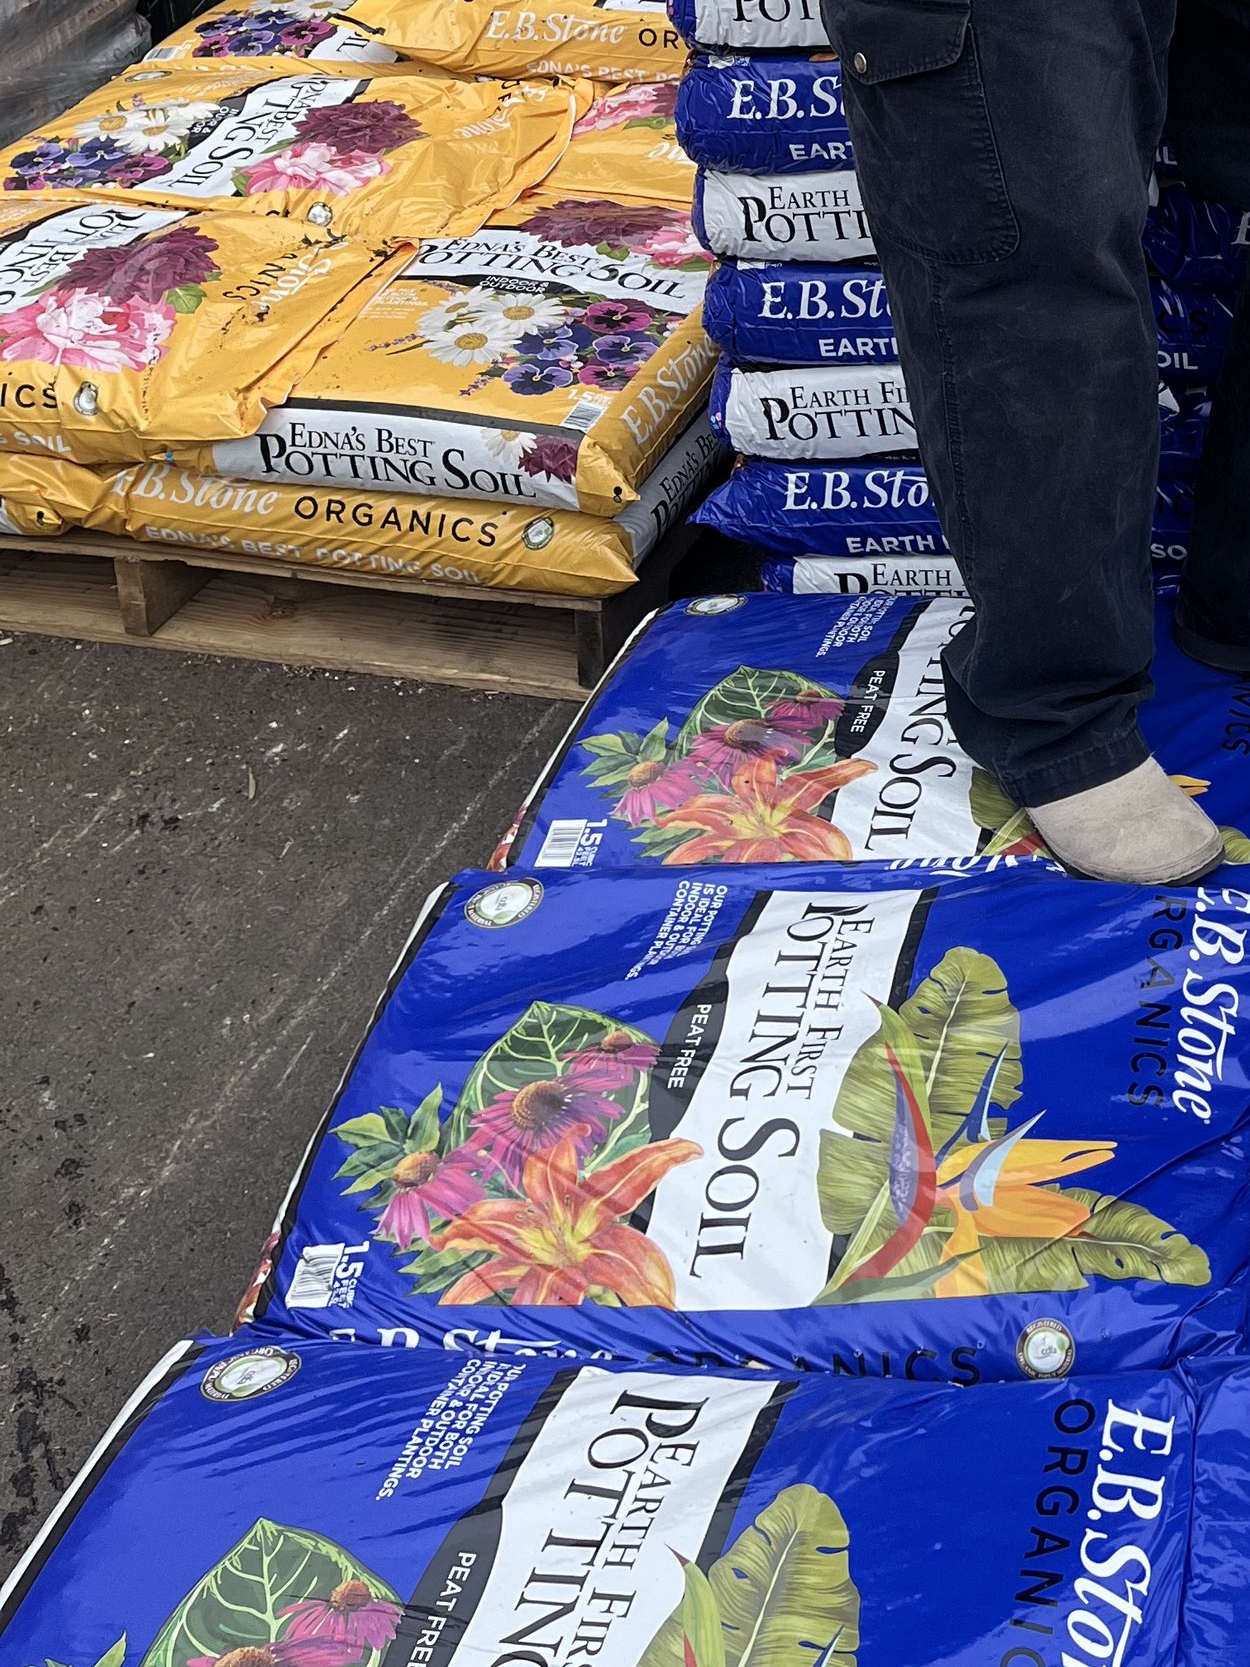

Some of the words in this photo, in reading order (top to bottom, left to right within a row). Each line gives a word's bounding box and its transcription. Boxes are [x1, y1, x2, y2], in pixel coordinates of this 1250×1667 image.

[168, 144, 254, 188] SOIL
[768, 185, 850, 210] EARTH
[531, 239, 600, 266] BEST
[478, 279, 547, 295] OUTDOOR
[485, 275, 536, 288] INDOOR
[585, 262, 687, 300] SOIL
[789, 384, 870, 409] EARTH
[288, 420, 367, 455] EDNA'S
[374, 427, 435, 461] BEST
[256, 431, 438, 487] POTTING
[441, 448, 538, 499] SOIL
[293, 495, 501, 548] ORGANICS
[240, 537, 304, 560] BEST
[429, 562, 486, 588] SOIL
[845, 535, 936, 554] EARTH
[872, 562, 952, 586] EARTH
[864, 670, 886, 702] PEAT
[850, 704, 874, 734] FREE
[865, 753, 958, 852] SOIL
[580, 818, 608, 847] 1.5
[655, 880, 691, 939] CONTAINER
[677, 882, 703, 924] INDOOR
[713, 885, 728, 909] OUR
[813, 915, 877, 1013] EARTH
[684, 1003, 711, 1049] PEAT
[666, 1050, 700, 1089] FREE
[785, 1022, 843, 1101] FIRST
[691, 1117, 799, 1281] SOIL
[335, 1240, 370, 1279] 1.5
[425, 1358, 482, 1416] CONTAINER
[448, 1398, 464, 1408] &
[451, 1402, 479, 1430] FOR
[465, 1381, 510, 1435] POTTING
[375, 1417, 435, 1502] PLANTINGS.
[405, 1409, 456, 1479] OUTDOOR
[428, 1431, 461, 1471] BOTH
[444, 1436, 474, 1470] SOIL
[601, 1439, 701, 1571] EARTH
[435, 1551, 477, 1612] PEAT
